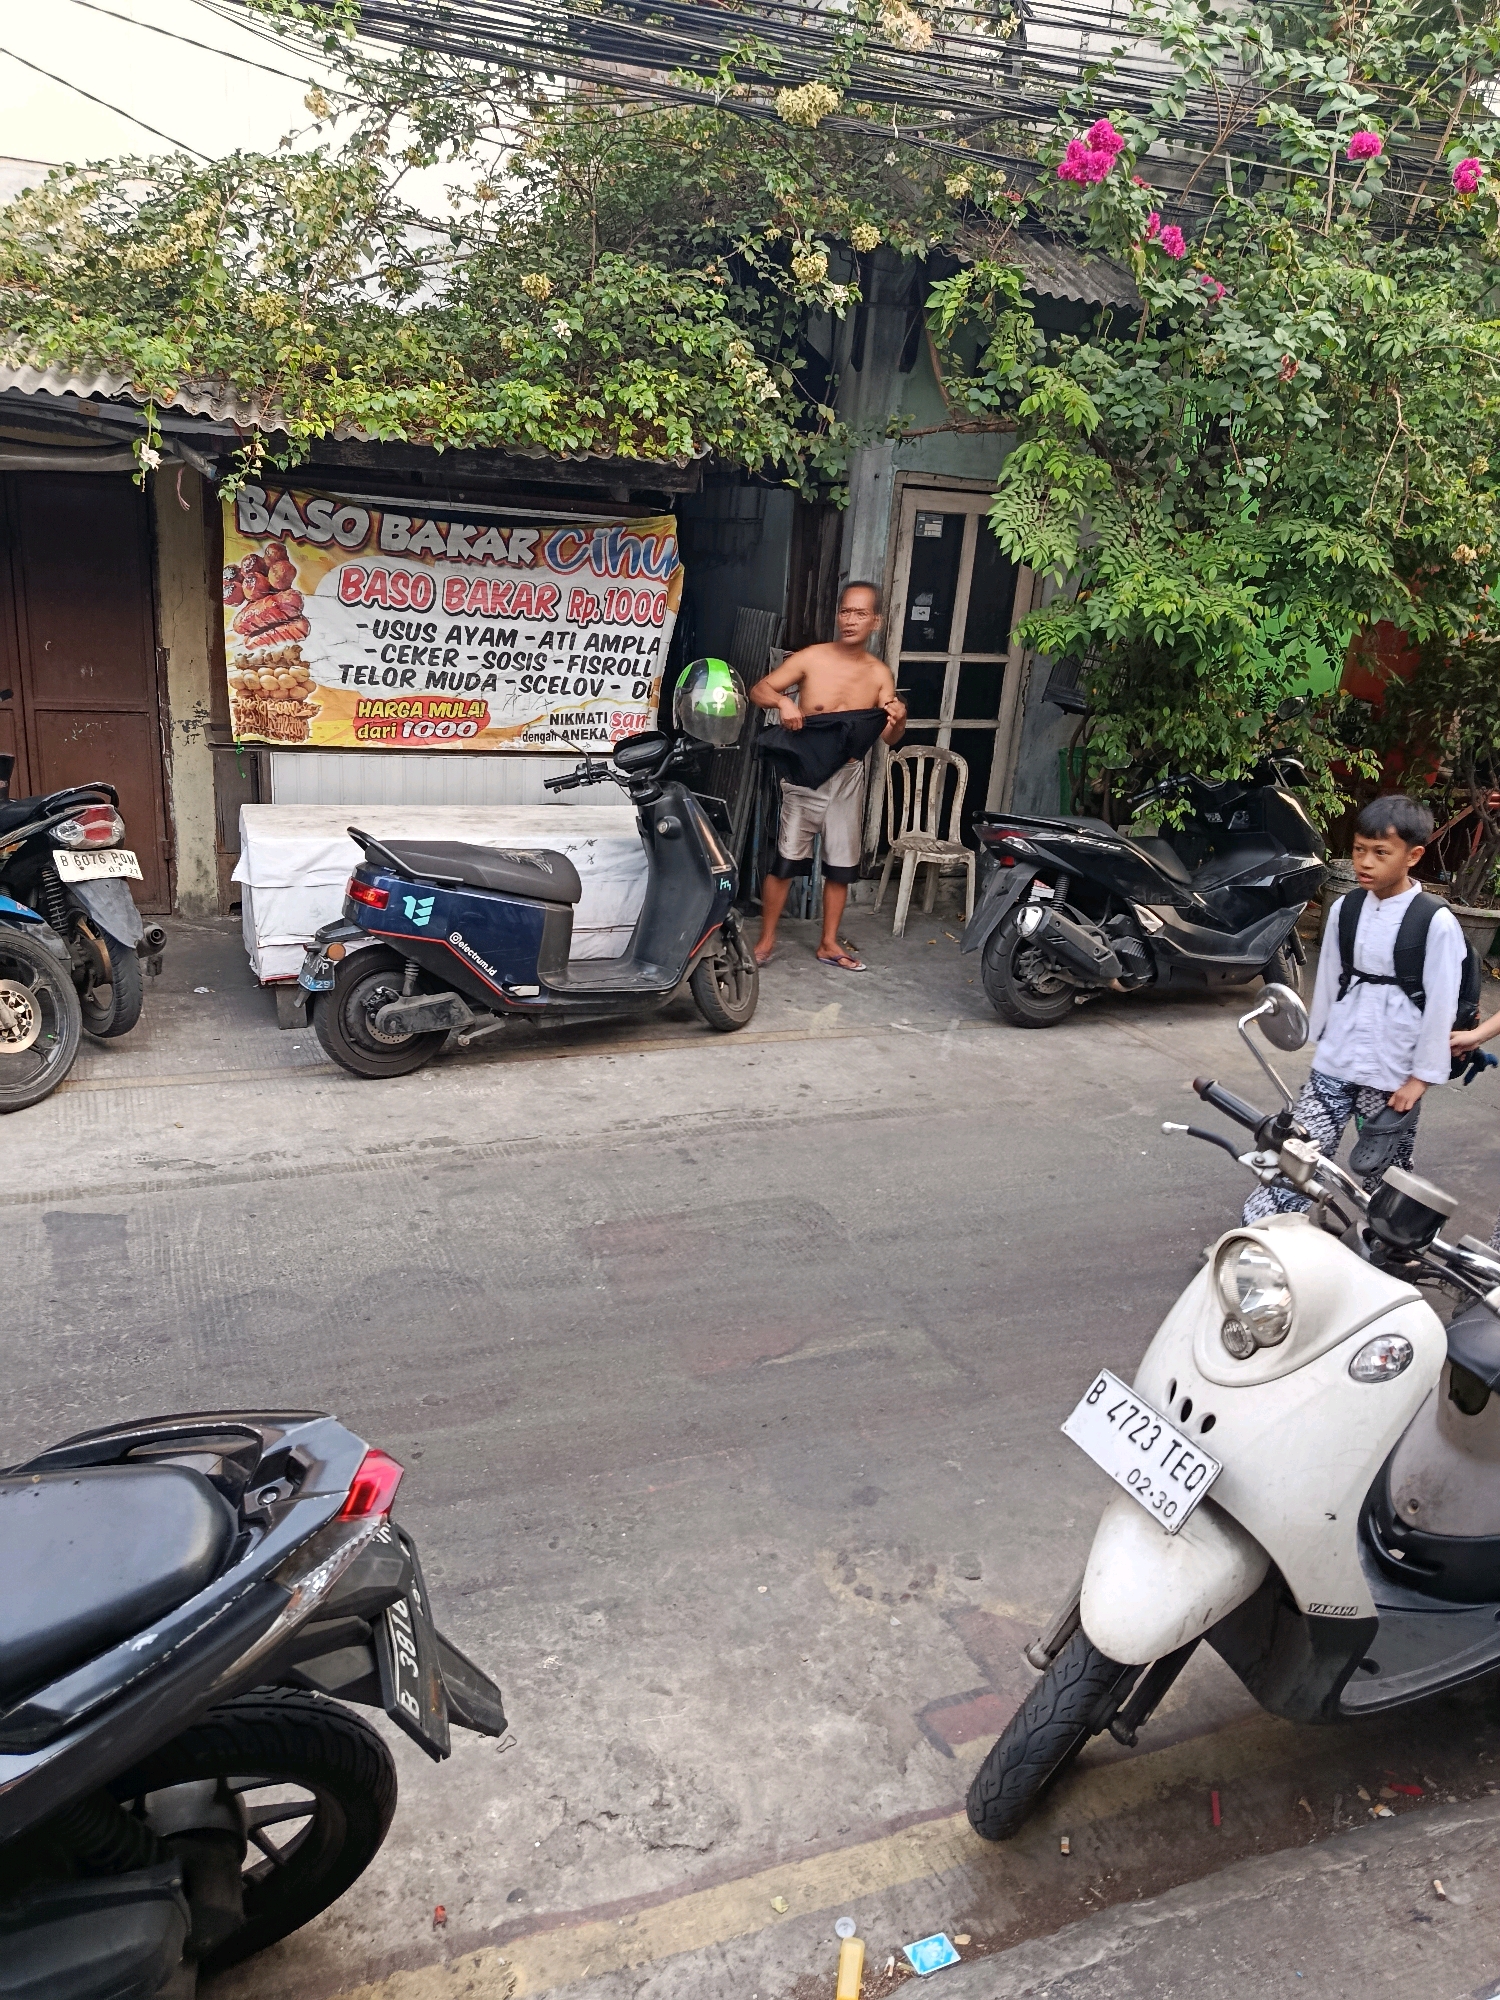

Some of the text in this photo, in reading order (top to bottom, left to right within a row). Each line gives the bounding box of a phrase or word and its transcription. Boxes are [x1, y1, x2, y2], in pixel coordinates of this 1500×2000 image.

[236, 484, 371, 549] BASO
[381, 513, 540, 564] BAKAR
[339, 566, 436, 611] BASO
[442, 576, 559, 621] BAKAR
[445, 625, 518, 648] AYAM
[583, 633, 661, 655] AMPLA
[338, 664, 417, 688] TELOR
[425, 670, 498, 691] MUDA
[358, 701, 487, 718] HARGA MULAI
[549, 711, 608, 725] NIKMATI
[357, 720, 478, 739] dari 1000
[522, 730, 557, 744] dengan
[561, 728, 608, 741] ANEKA
[59, 855, 69, 867] B
[73, 853, 107, 867] 6076
[1086, 1378, 1207, 1492] B 4723 TEQ
[1308, 1603, 1358, 1616] YAMAHA
[400, 1688, 420, 1720] B
